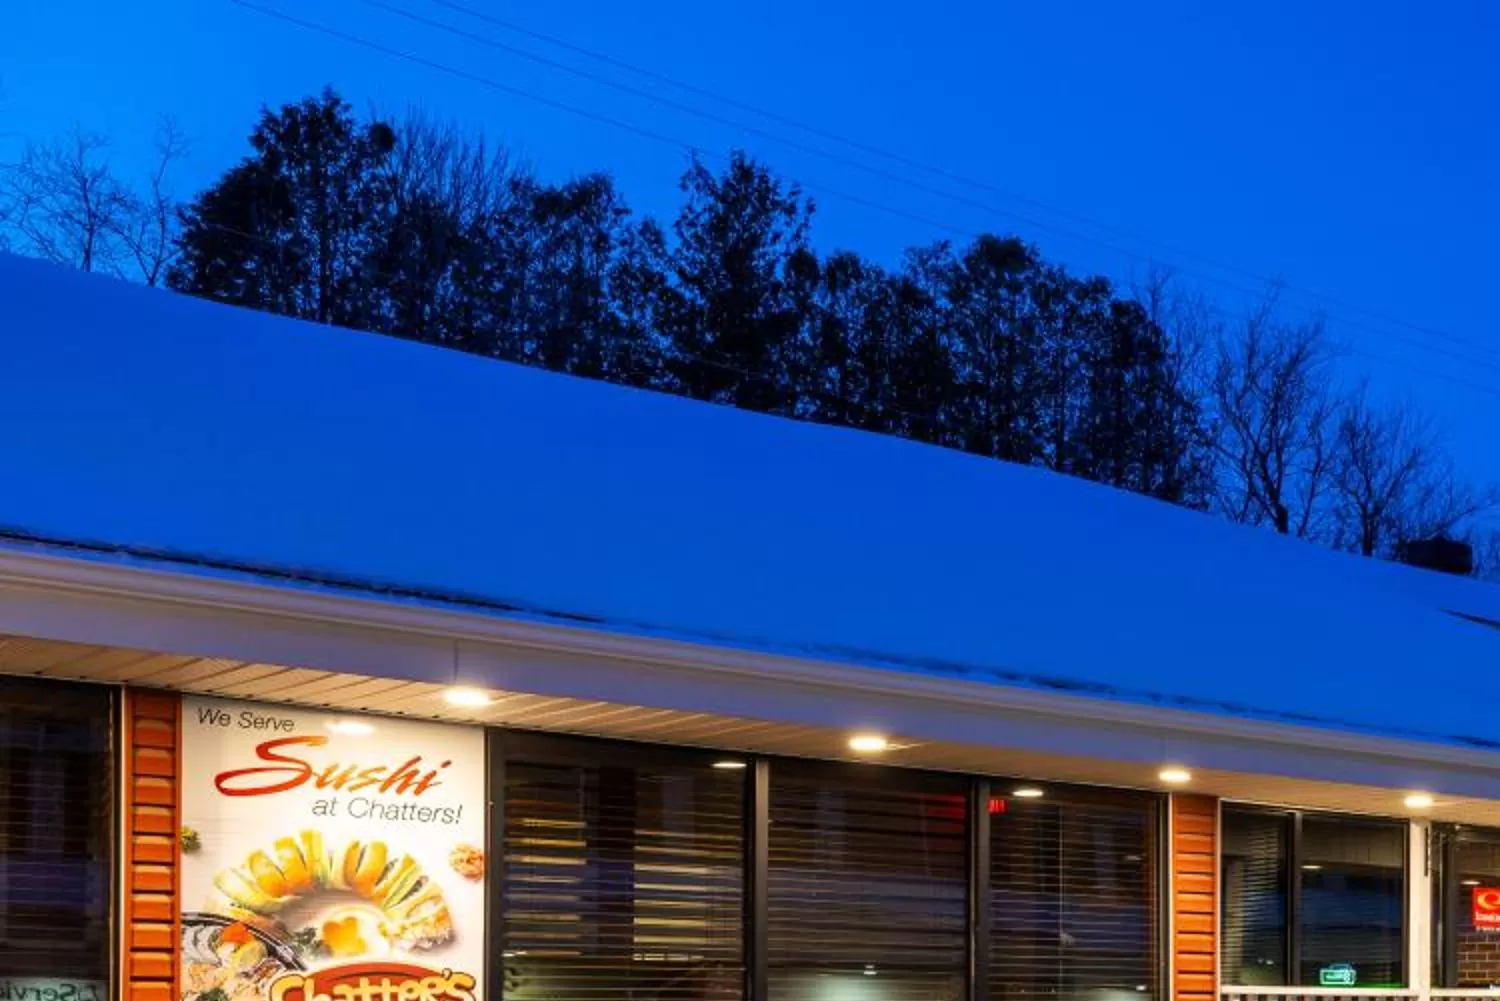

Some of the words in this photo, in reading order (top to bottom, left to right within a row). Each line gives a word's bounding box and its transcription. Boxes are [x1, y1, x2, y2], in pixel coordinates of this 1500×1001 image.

[198, 707, 231, 727] We
[238, 711, 295, 732] Serve
[214, 735, 452, 796] Sushi
[312, 798, 338, 817] at
[347, 797, 463, 824] Chatters!
